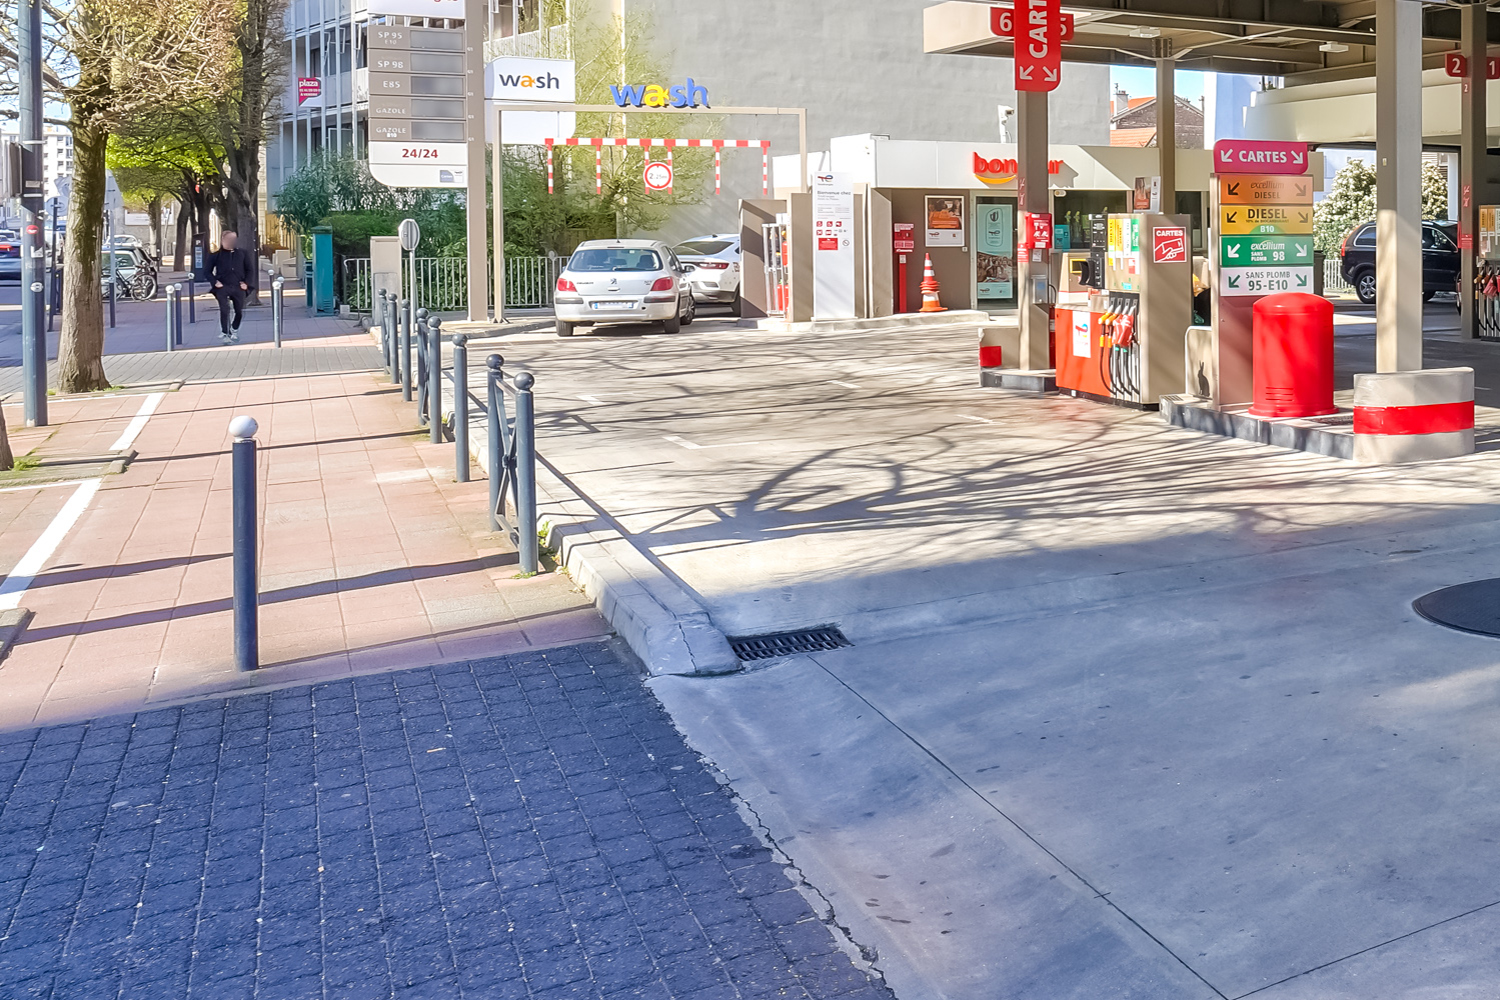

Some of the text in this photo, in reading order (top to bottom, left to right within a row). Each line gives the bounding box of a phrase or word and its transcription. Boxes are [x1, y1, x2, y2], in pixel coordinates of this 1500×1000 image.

[1000, 12, 1012, 32] 6
[392, 32, 403, 40] 95
[377, 60, 404, 69] SP 98
[1452, 58, 1461, 73] 2
[1488, 60, 1496, 76] 1
[383, 80, 401, 89] E85
[499, 72, 560, 90] wash
[609, 77, 710, 108] wash
[1464, 84, 1468, 92] 2
[402, 148, 439, 158] 24/24
[1239, 150, 1287, 163] CARTES
[1250, 181, 1284, 189] excellium
[1254, 191, 1280, 199] DIESEL
[1247, 208, 1288, 219] DIESEL
[1260, 225, 1274, 233] B10
[1250, 241, 1285, 250] excellium
[1272, 251, 1285, 261] 98
[1246, 271, 1264, 279] SANS
[1248, 280, 1288, 291] 95-E10
